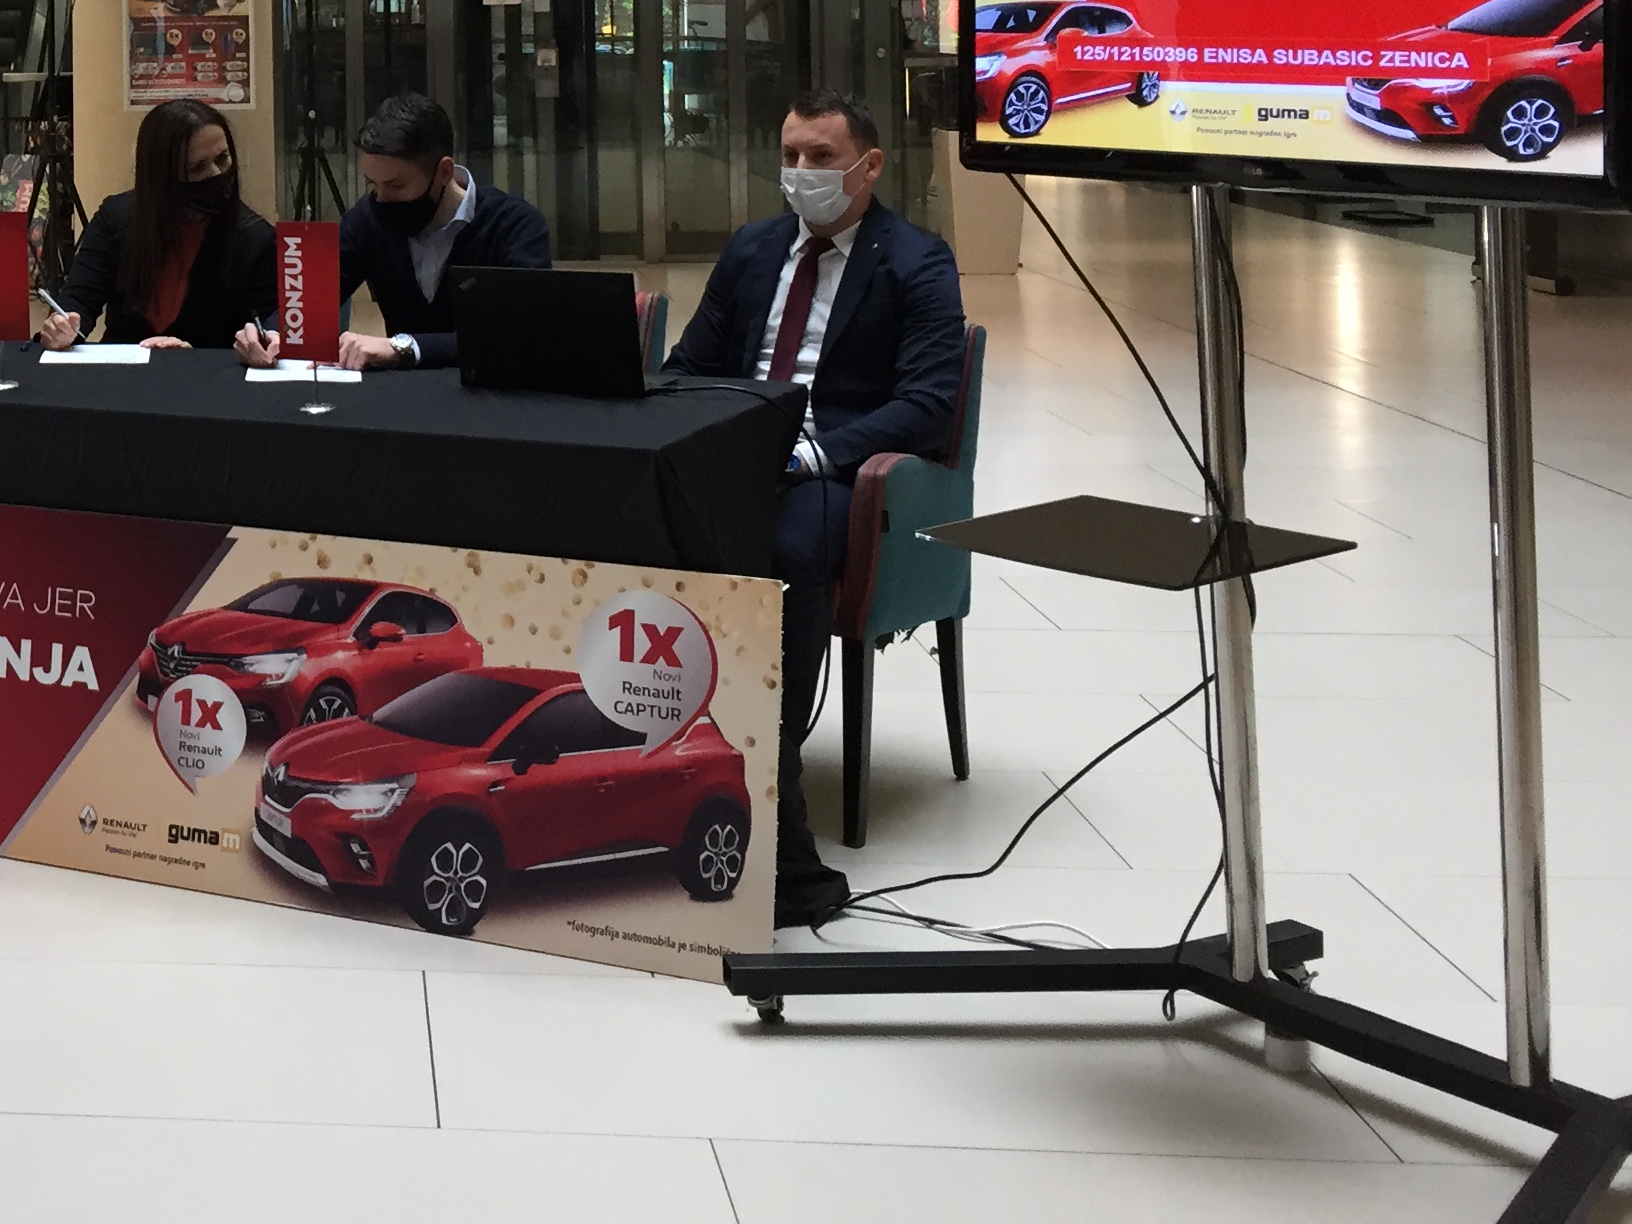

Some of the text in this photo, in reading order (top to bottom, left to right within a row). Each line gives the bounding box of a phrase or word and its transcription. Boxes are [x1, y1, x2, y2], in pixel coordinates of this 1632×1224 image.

[1072, 45, 1470, 69] 125/12150396 ENISA SUBASIC ZENICA
[1257, 107, 1310, 122] guma
[283, 236, 305, 346] KONZUM
[33, 586, 97, 620] JER
[607, 608, 686, 669] 1x
[652, 668, 682, 683] Novi
[621, 680, 683, 702] Renault
[173, 687, 225, 731] 1x
[613, 699, 683, 722] CAPTUR
[179, 728, 201, 742] Novi
[178, 740, 223, 758] Renault
[177, 756, 206, 771] CLIO
[101, 816, 148, 833] RENAULT
[167, 822, 220, 846] guma
[621, 929, 676, 950] automobila
[677, 940, 688, 954] je
